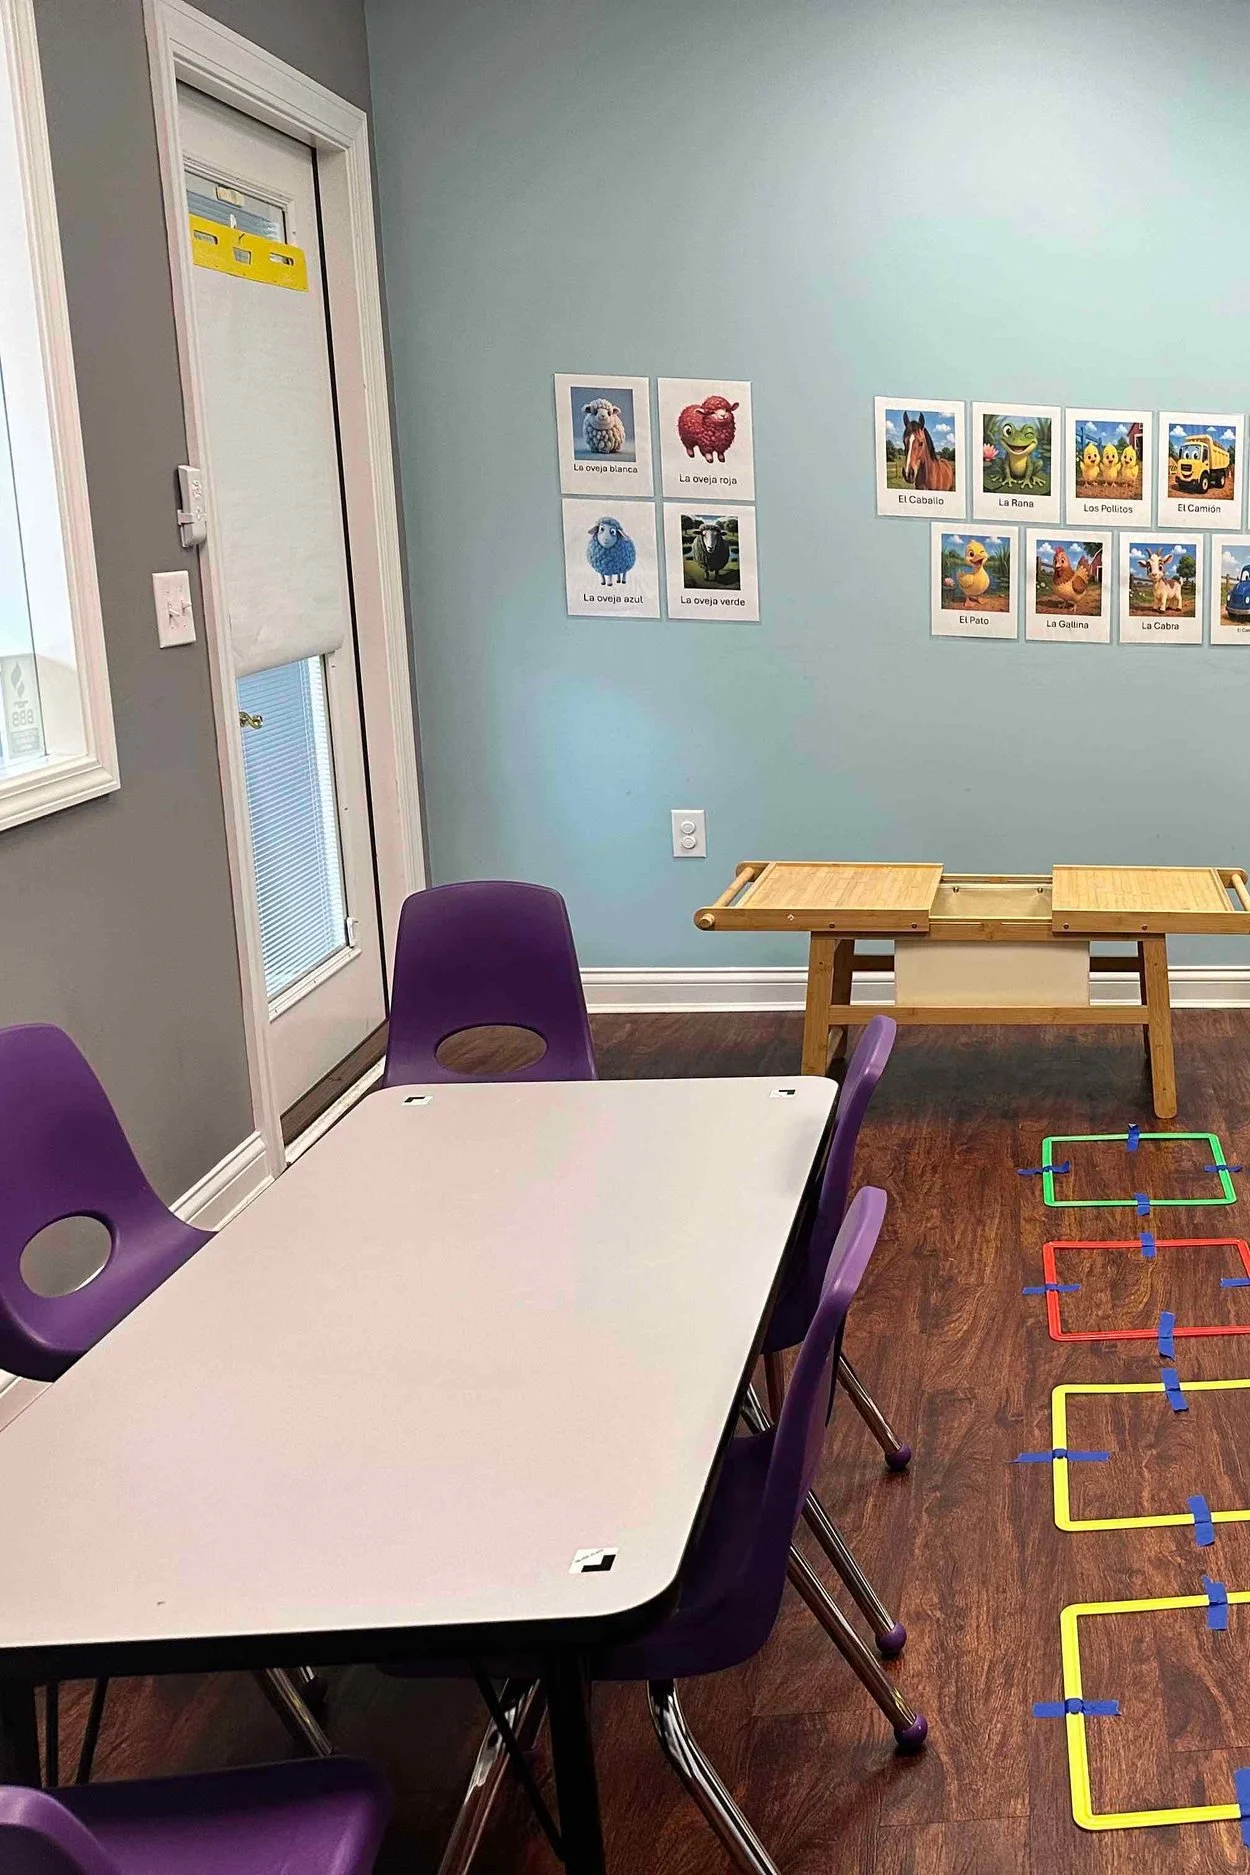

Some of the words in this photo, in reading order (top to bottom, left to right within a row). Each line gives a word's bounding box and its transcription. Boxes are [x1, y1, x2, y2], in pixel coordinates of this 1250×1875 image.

[573, 463, 584, 472] La
[585, 465, 608, 474] oveja
[609, 464, 639, 474] blanca
[679, 473, 691, 483] La
[692, 475, 718, 486] oveja
[719, 476, 738, 487] roja
[898, 494, 908, 504] El
[908, 495, 945, 506] Caballo
[998, 498, 1010, 507] La
[1011, 498, 1034, 508] Rana
[1083, 503, 1100, 513] Los
[1101, 504, 1134, 514] Pollitos
[1177, 503, 1186, 512] El
[1187, 503, 1221, 514] Camión
[583, 593, 595, 602] La
[596, 594, 622, 605] oveja
[623, 595, 644, 604] azul
[680, 595, 692, 605] La
[693, 596, 719, 607] oveja
[719, 597, 746, 607] verde
[959, 615, 969, 624] El
[969, 615, 990, 626] Pato
[1046, 619, 1057, 628] La
[1058, 619, 1089, 630] Gallina
[1141, 622, 1153, 630] La
[1153, 621, 1180, 631] Cabra
